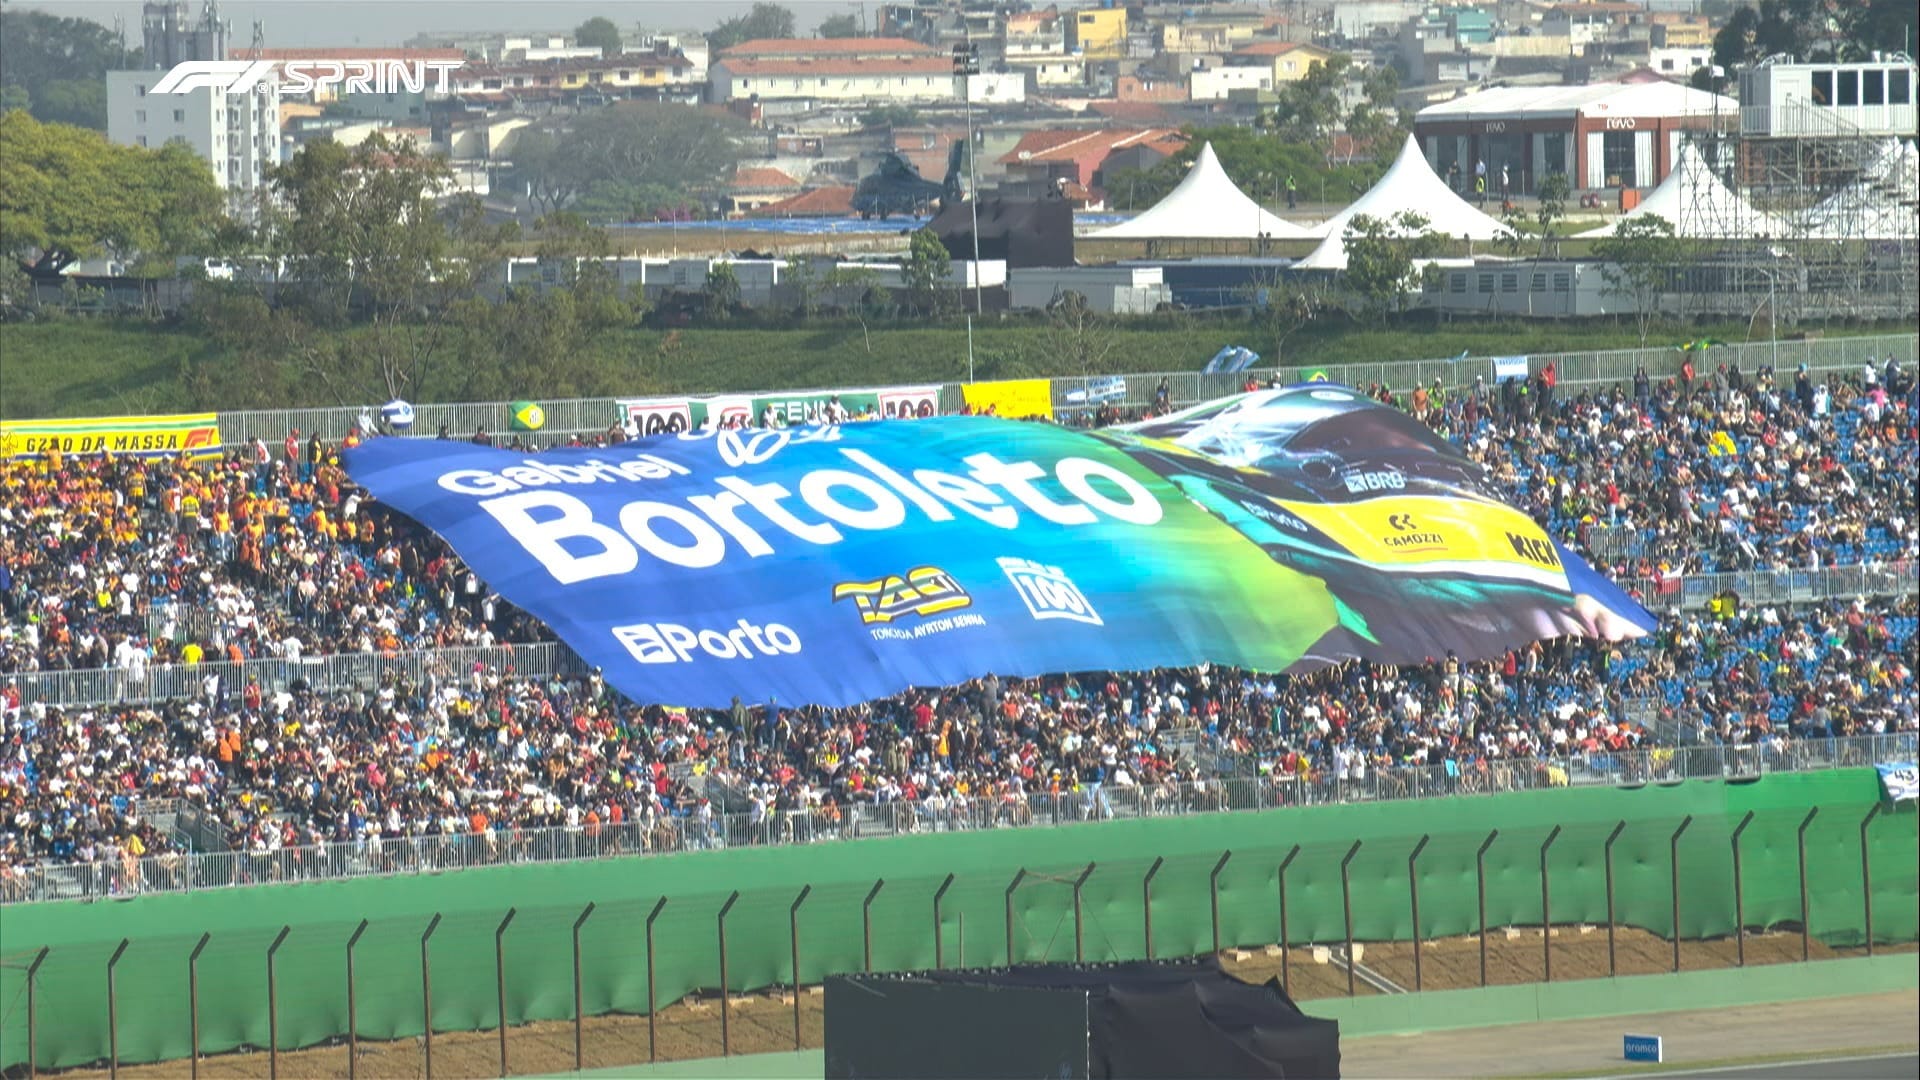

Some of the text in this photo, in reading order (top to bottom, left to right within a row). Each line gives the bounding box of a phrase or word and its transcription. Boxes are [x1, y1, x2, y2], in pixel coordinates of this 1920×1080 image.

[81, 436, 106, 452] DA
[114, 434, 177, 450] MASSA
[437, 454, 692, 496] Gabriel
[478, 448, 1163, 586] Bortoleto
[1384, 533, 1444, 547] CAMOZZI
[1018, 575, 1085, 615] 100
[655, 618, 802, 663] Porto
[914, 617, 953, 638] AYRTON
[953, 614, 987, 628] SENNA
[1625, 1042, 1658, 1054] aramco
